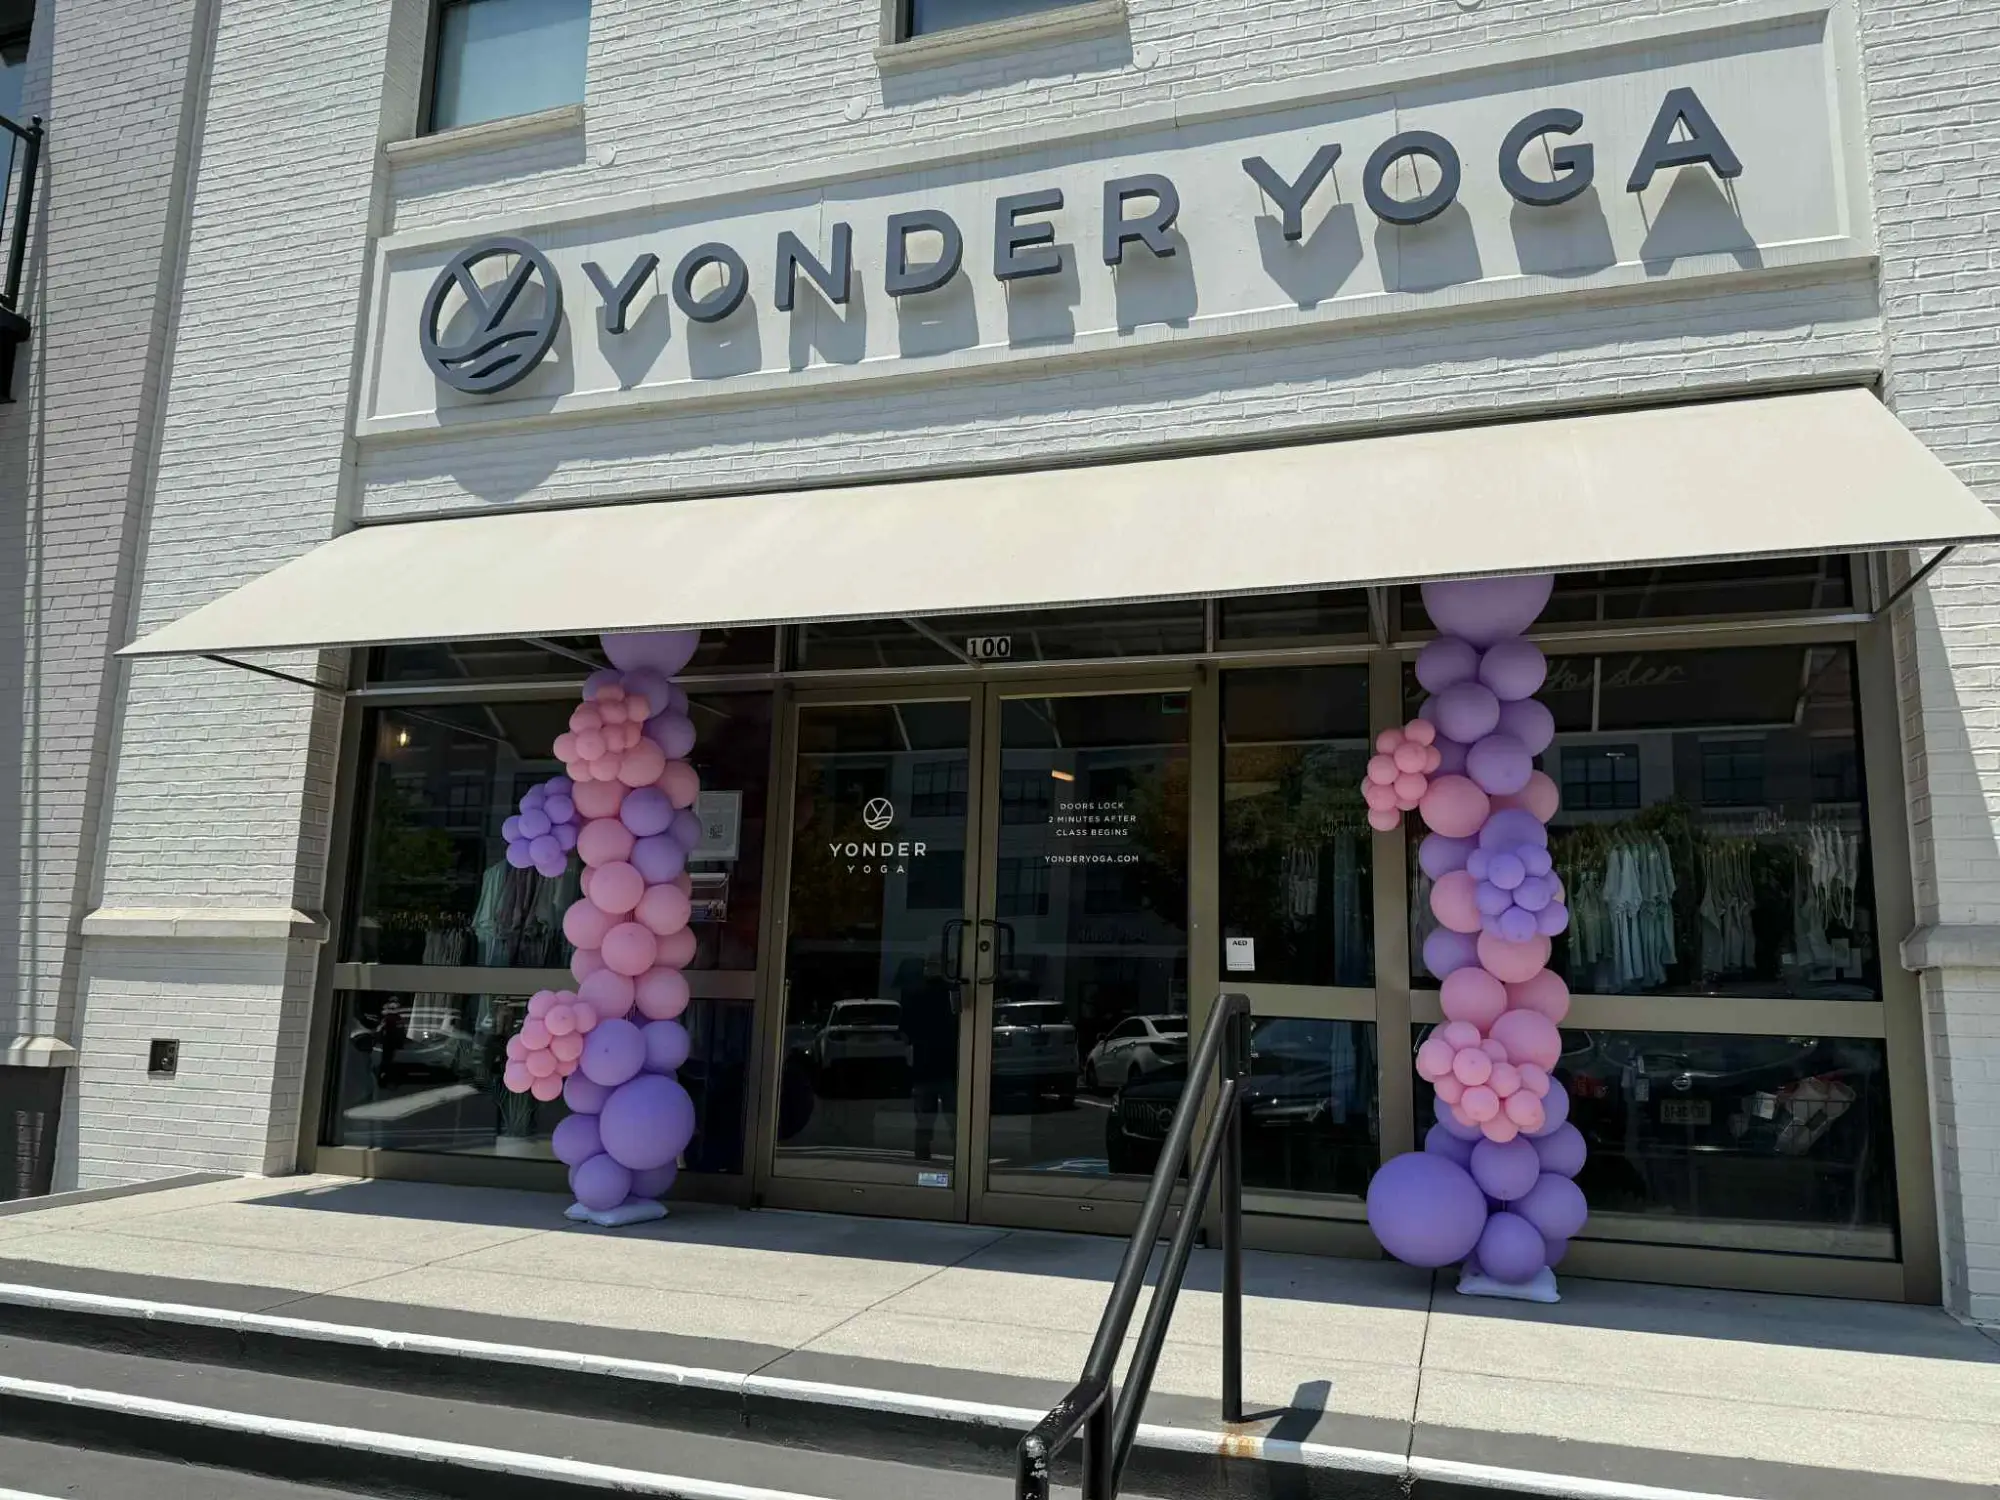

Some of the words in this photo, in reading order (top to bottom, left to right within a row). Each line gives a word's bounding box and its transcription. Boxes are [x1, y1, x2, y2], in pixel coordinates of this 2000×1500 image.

[581, 173, 1181, 334] YONDER
[1242, 87, 1743, 241] YOGA
[971, 638, 1009, 657] 100
[1098, 802, 1124, 810] LOCK
[1057, 815, 1101, 823] MINUTES
[829, 842, 927, 858] YONDER
[1045, 855, 1139, 863] YONDERYOGA.COM
[847, 865, 905, 874] YOGA
